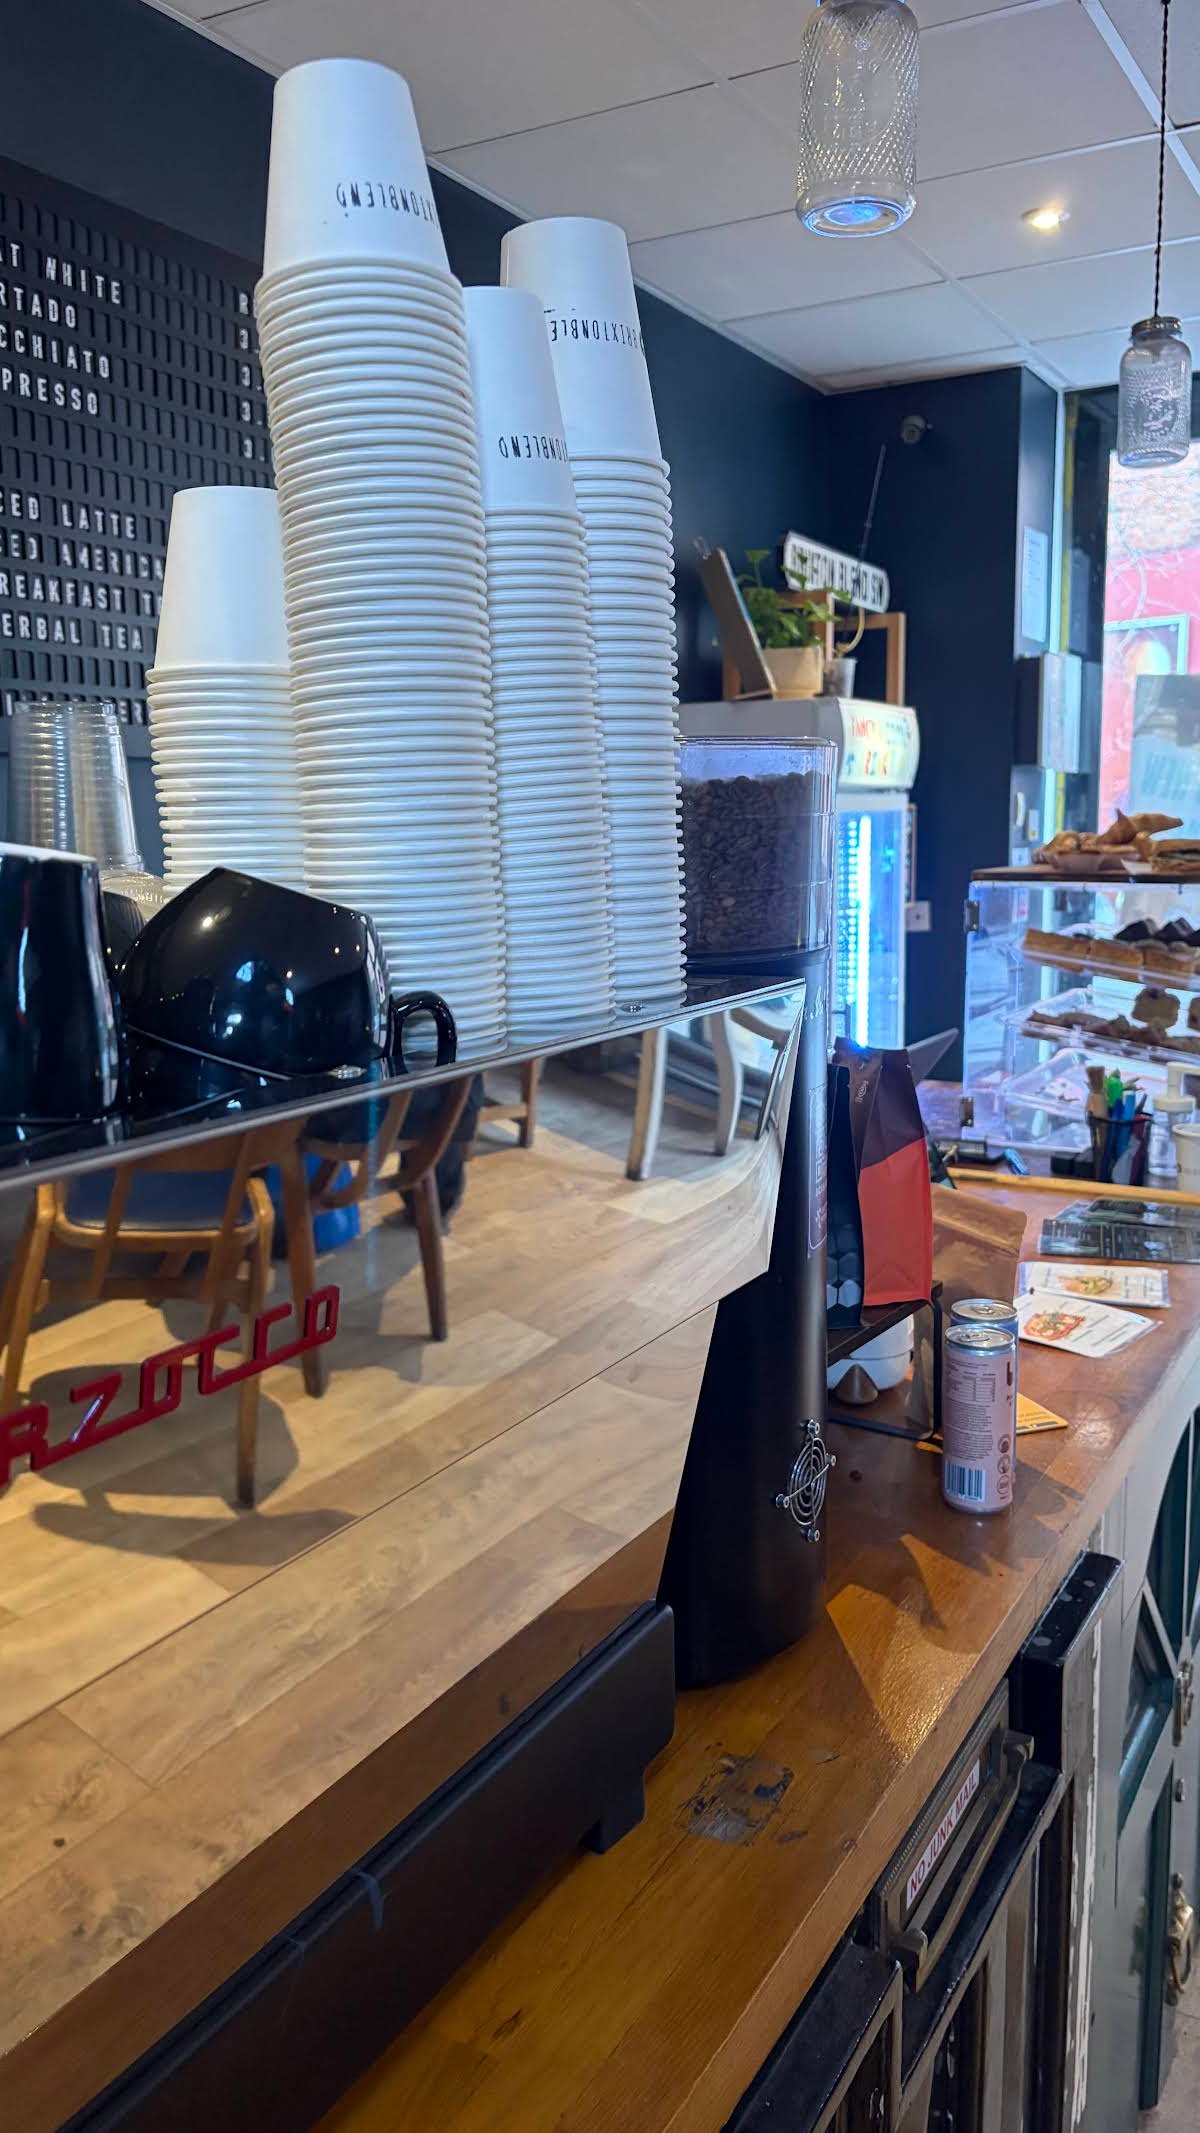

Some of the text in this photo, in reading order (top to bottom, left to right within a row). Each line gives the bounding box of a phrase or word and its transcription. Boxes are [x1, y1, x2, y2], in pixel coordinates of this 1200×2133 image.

[46, 257, 120, 304] WHITE
[2, 368, 98, 415] PRESSO
[62, 503, 135, 538] LATTE
[2, 613, 142, 650] ERBAL TEA
[910, 1772, 976, 1899] NO JUNK MAIL
